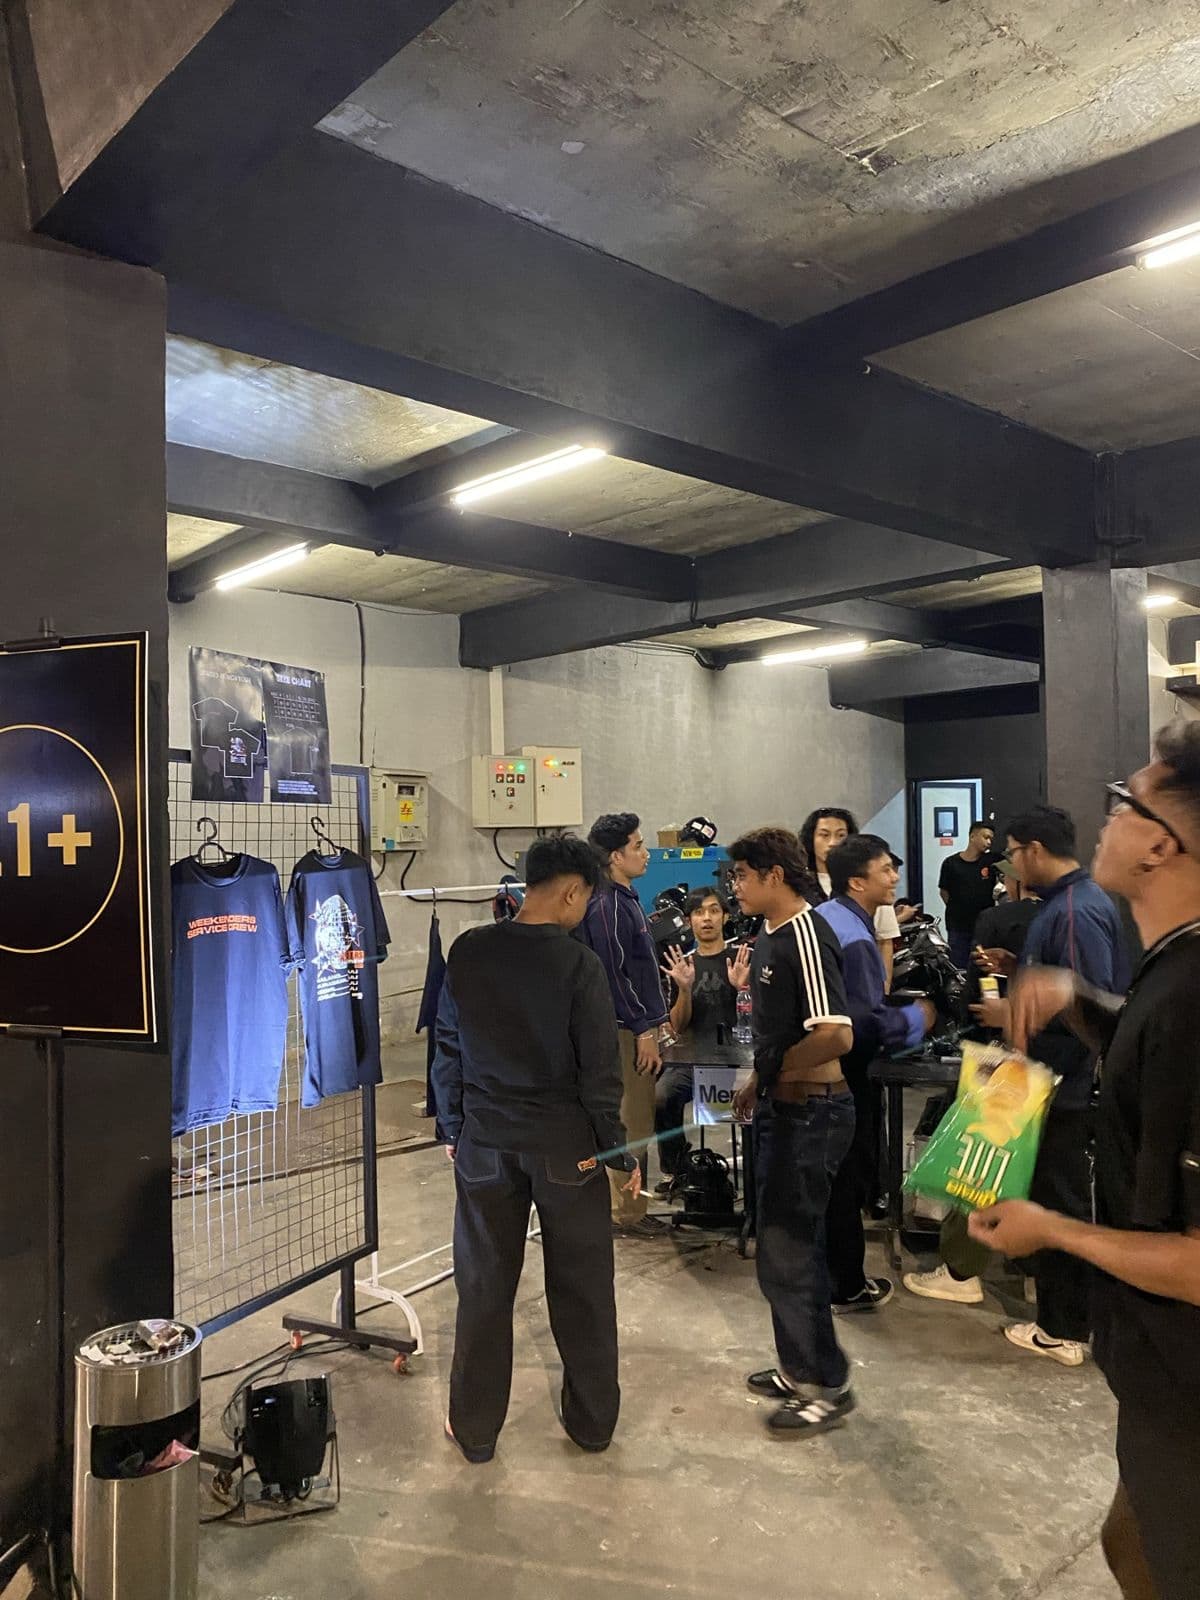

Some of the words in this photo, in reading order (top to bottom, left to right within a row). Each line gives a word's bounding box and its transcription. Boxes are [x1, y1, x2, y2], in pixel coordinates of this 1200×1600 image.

[0, 803, 92, 877] 1+
[187, 924, 228, 939] SERVICE
[228, 923, 258, 933] CREW
[188, 914, 256, 929] WEEKENDERS
[948, 1132, 1011, 1193] LITE
